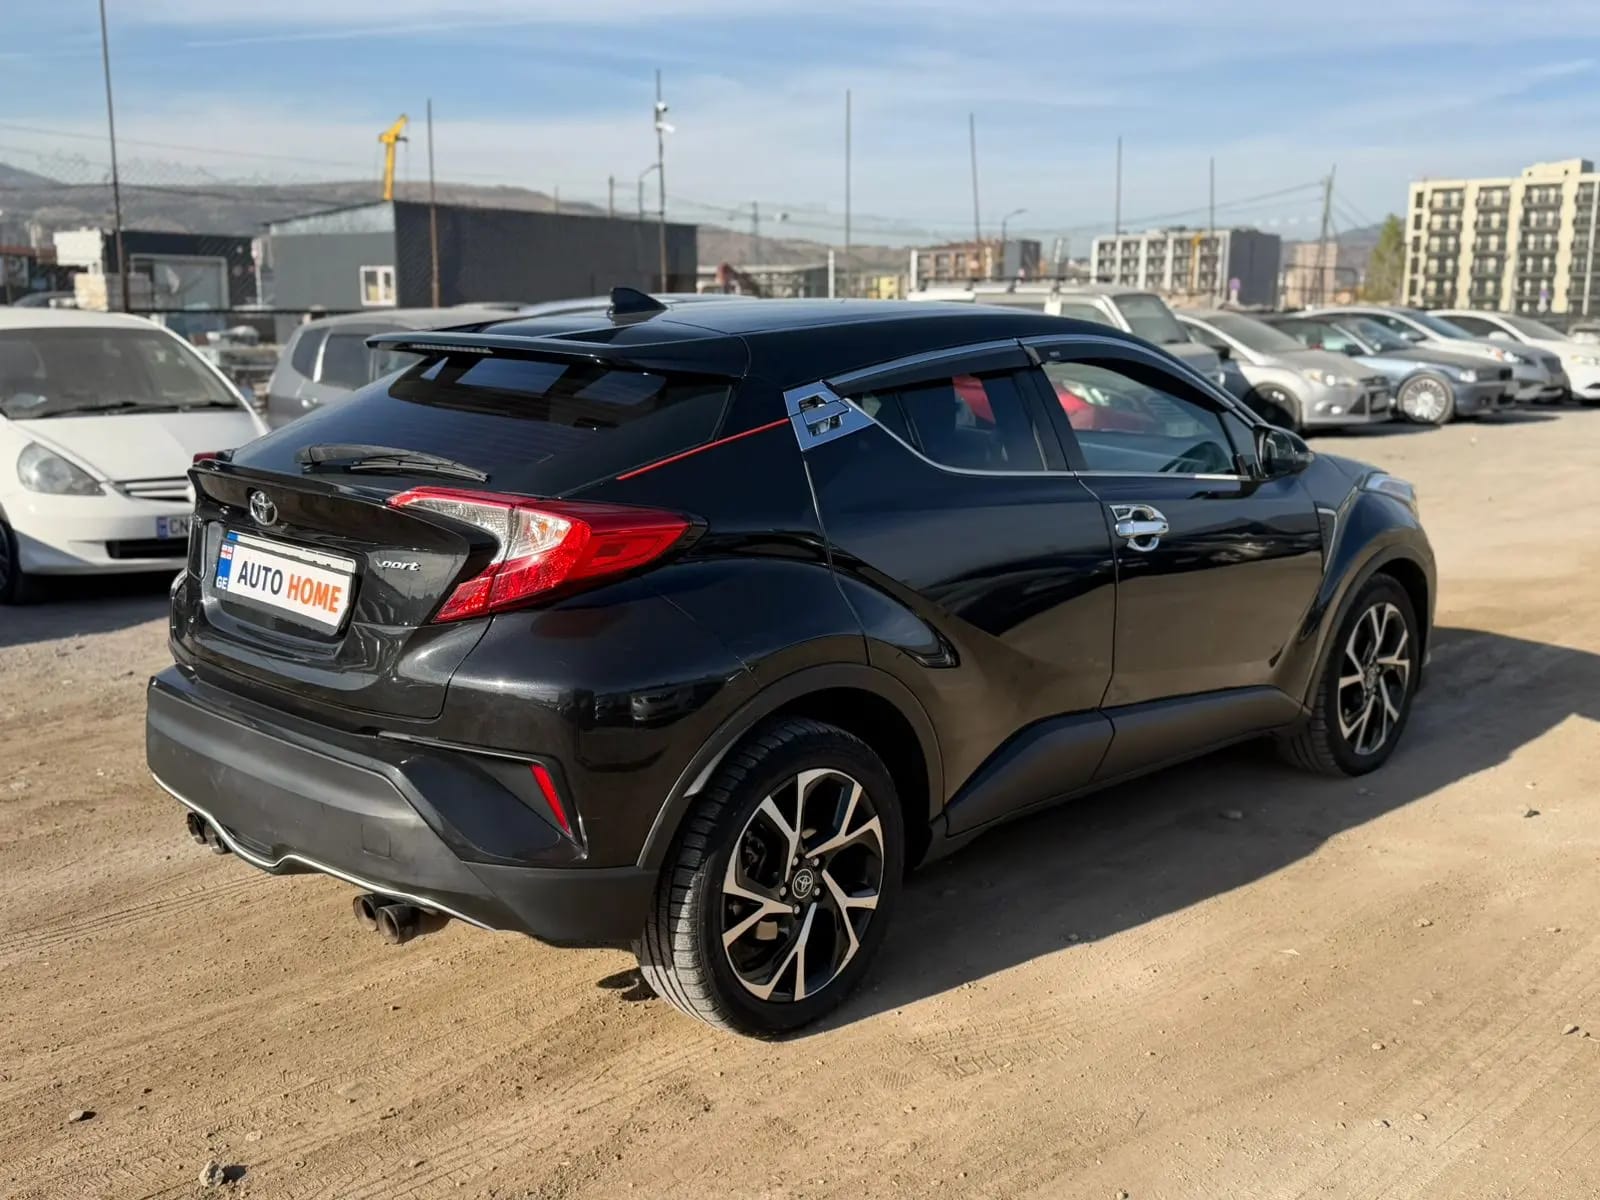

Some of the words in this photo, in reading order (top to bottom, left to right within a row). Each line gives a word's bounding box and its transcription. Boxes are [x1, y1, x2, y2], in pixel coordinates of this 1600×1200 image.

[215, 576, 228, 589] GE
[237, 560, 283, 595] AUTO
[287, 573, 342, 613] HOME
